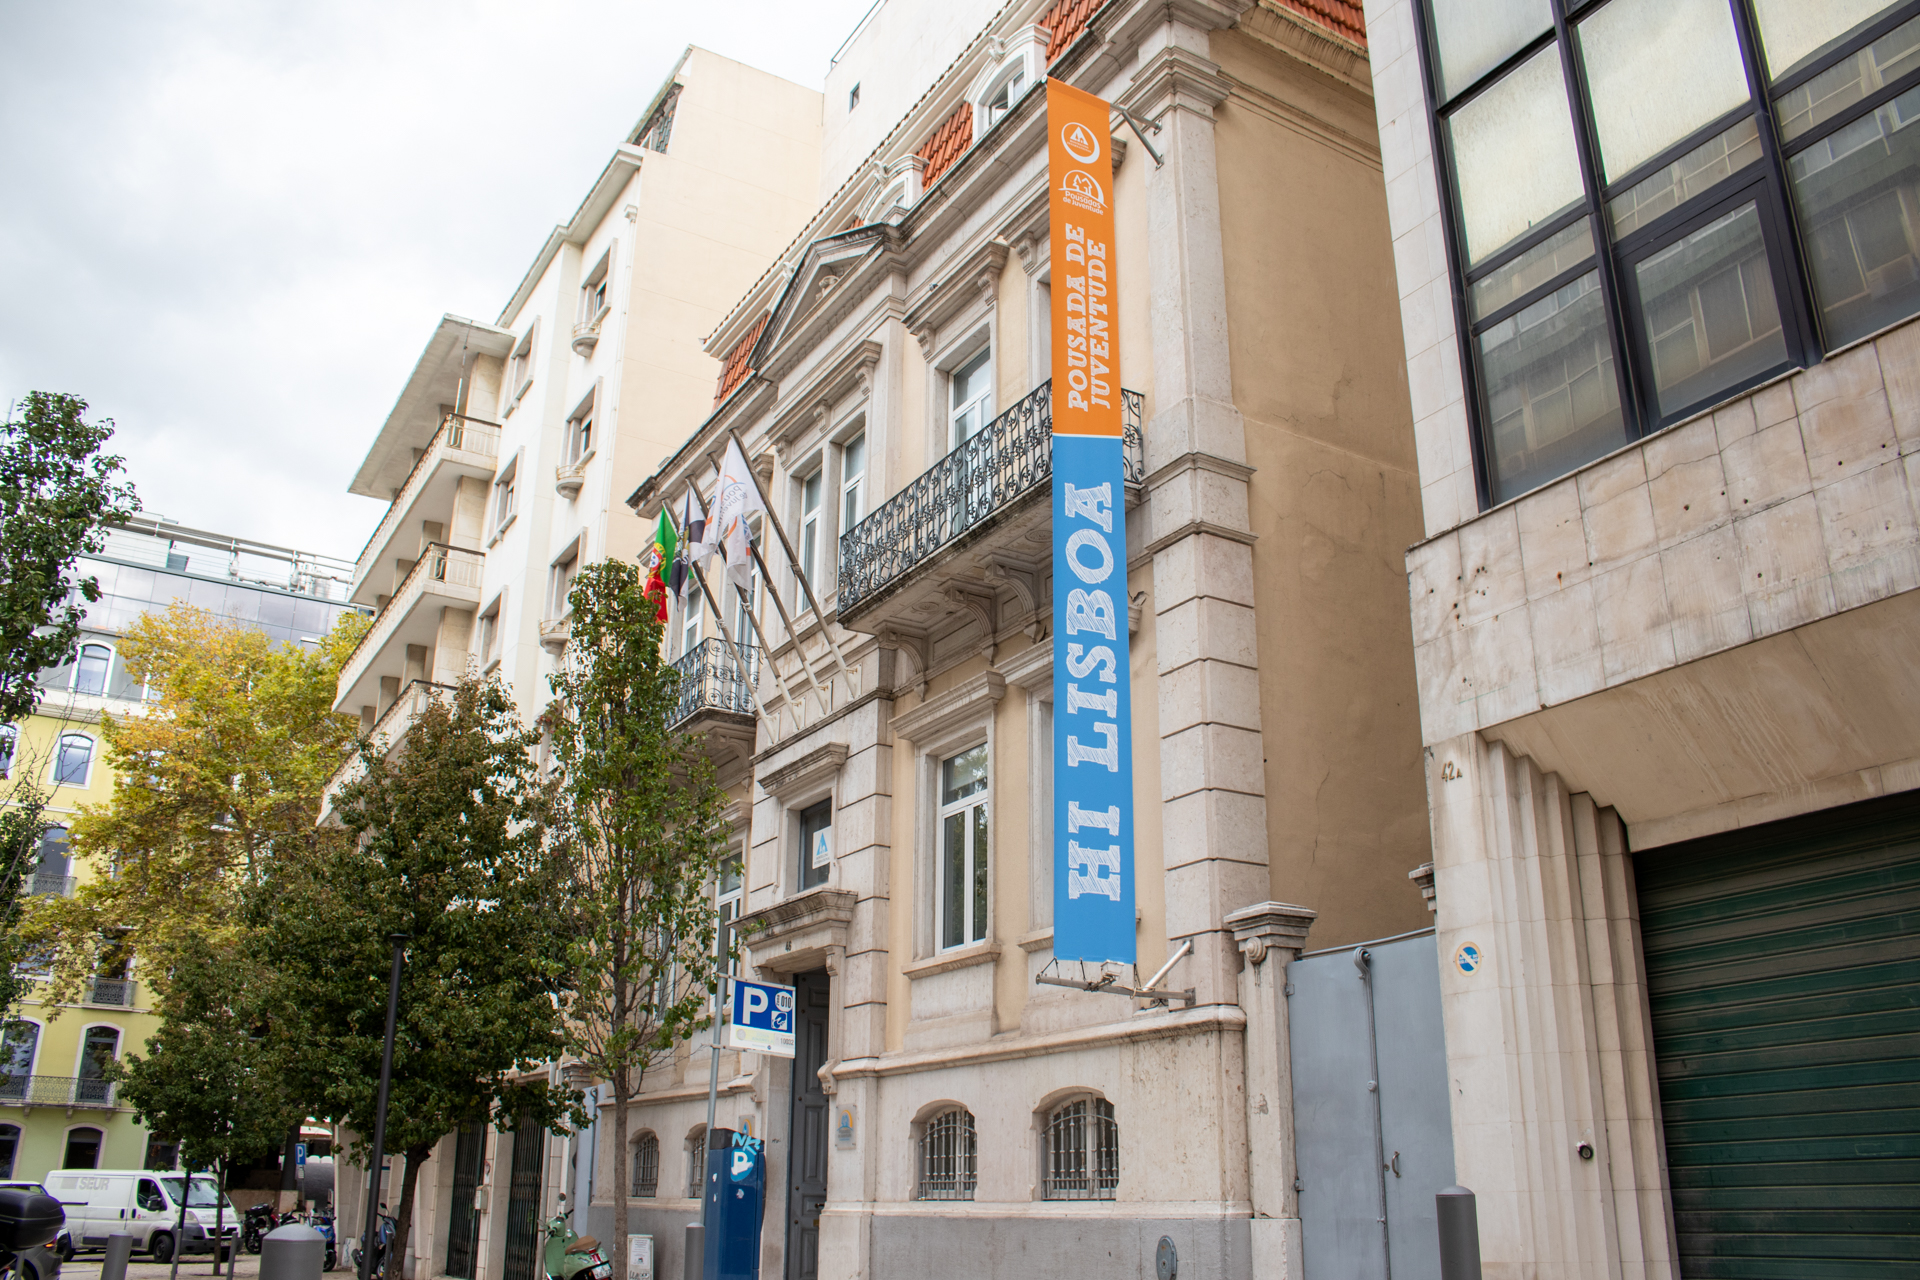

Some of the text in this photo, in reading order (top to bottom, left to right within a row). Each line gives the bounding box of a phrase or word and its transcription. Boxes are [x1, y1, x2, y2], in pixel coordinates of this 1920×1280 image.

[1063, 196, 1072, 204] de
[1065, 190, 1101, 209] Pousadas
[1065, 222, 1085, 266] DE
[1087, 238, 1111, 410] JUVENTUDE
[1066, 274, 1088, 412] POUSADA
[1065, 482, 1121, 901] HI LISBOA
[742, 986, 768, 1025] P
[781, 995, 792, 1009] 010
[297, 1146, 304, 1163] P
[79, 1177, 110, 1190] SEUR
